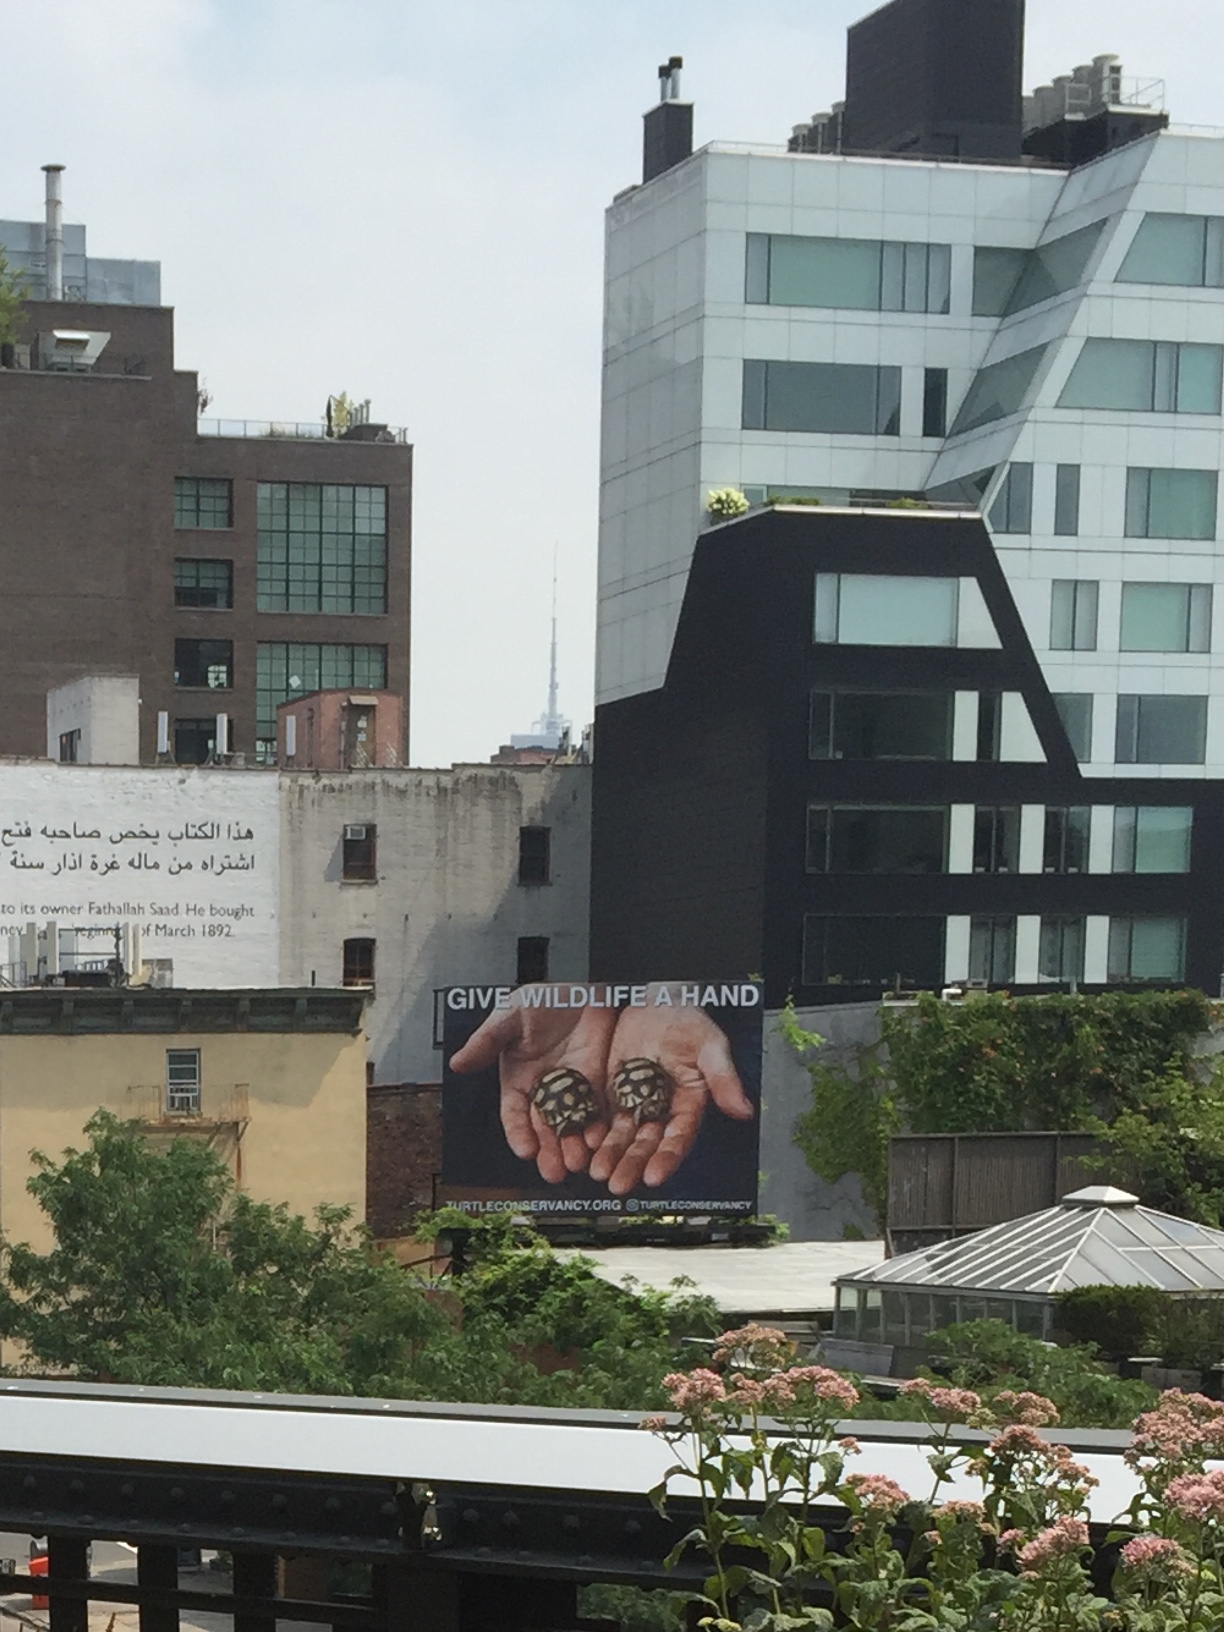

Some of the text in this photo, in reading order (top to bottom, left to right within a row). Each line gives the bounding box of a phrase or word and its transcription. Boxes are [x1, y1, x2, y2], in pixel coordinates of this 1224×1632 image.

[1, 821, 32, 847] فتح
[40, 821, 101, 844] صاحبه
[109, 823, 160, 846] يخص
[168, 821, 220, 847] الكتاب
[227, 822, 254, 841] هذا
[10, 850, 45, 870] سنة
[90, 853, 121, 876] غرة
[128, 852, 160, 870] ماله
[168, 857, 193, 876] من
[201, 853, 255, 876] اشتراه
[1, 903, 15, 915] to
[20, 902, 36, 915] its
[40, 906, 83, 916] owner
[88, 901, 145, 916] Fathallah
[185, 903, 206, 917] He
[210, 903, 255, 921] bought
[155, 923, 196, 937] March
[447, 984, 759, 1010] GIVE WILDLIFE A HAND
